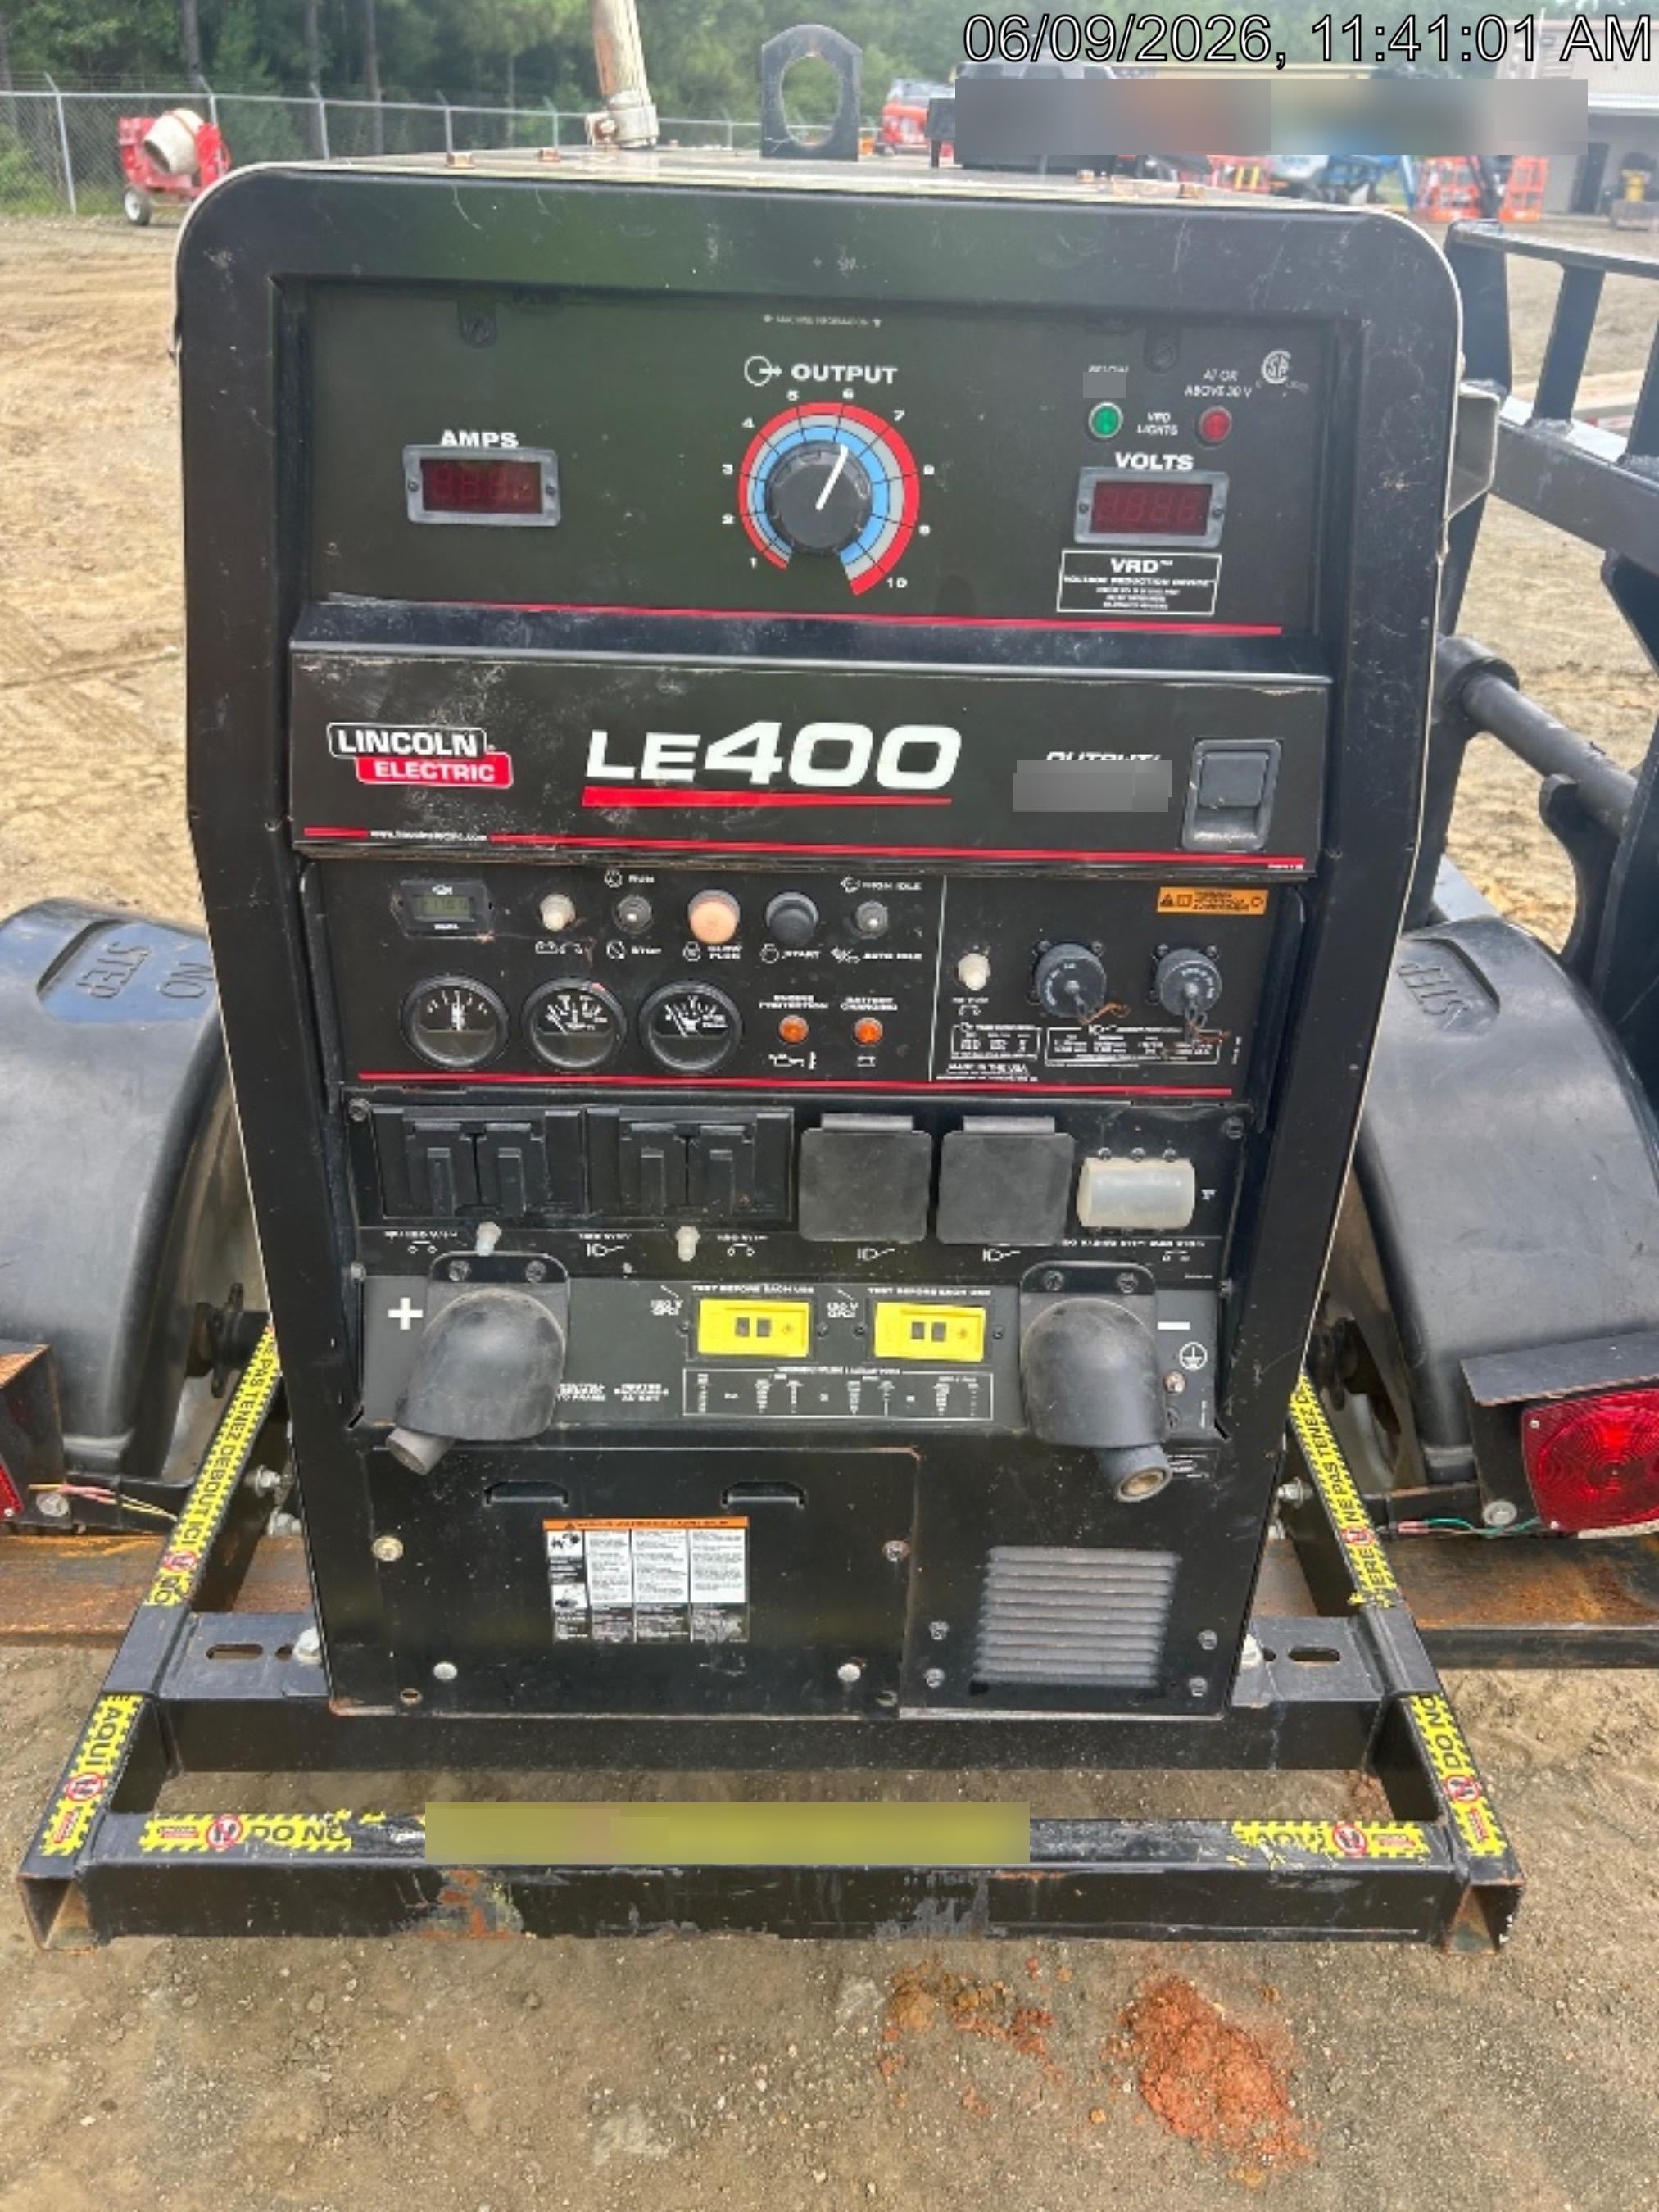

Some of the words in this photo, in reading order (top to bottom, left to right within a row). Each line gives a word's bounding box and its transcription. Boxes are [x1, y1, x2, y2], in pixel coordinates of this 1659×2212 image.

[791, 364, 898, 384] OUTPUT
[786, 389, 800, 401] 5
[842, 388, 854, 400] 6
[1242, 387, 1253, 398] V
[894, 410, 905, 423] 7
[741, 417, 755, 429] 4
[1136, 424, 1178, 436] LIGHTS
[440, 431, 519, 447] AMPS
[1115, 452, 1194, 472] VOLTS
[722, 463, 733, 475] 3
[722, 514, 735, 525] 2
[749, 556, 757, 568] 1
[886, 577, 908, 588] 10
[337, 728, 478, 758] LINCOLN
[585, 720, 963, 790] LE400
[374, 760, 496, 782] ELECTRIC
